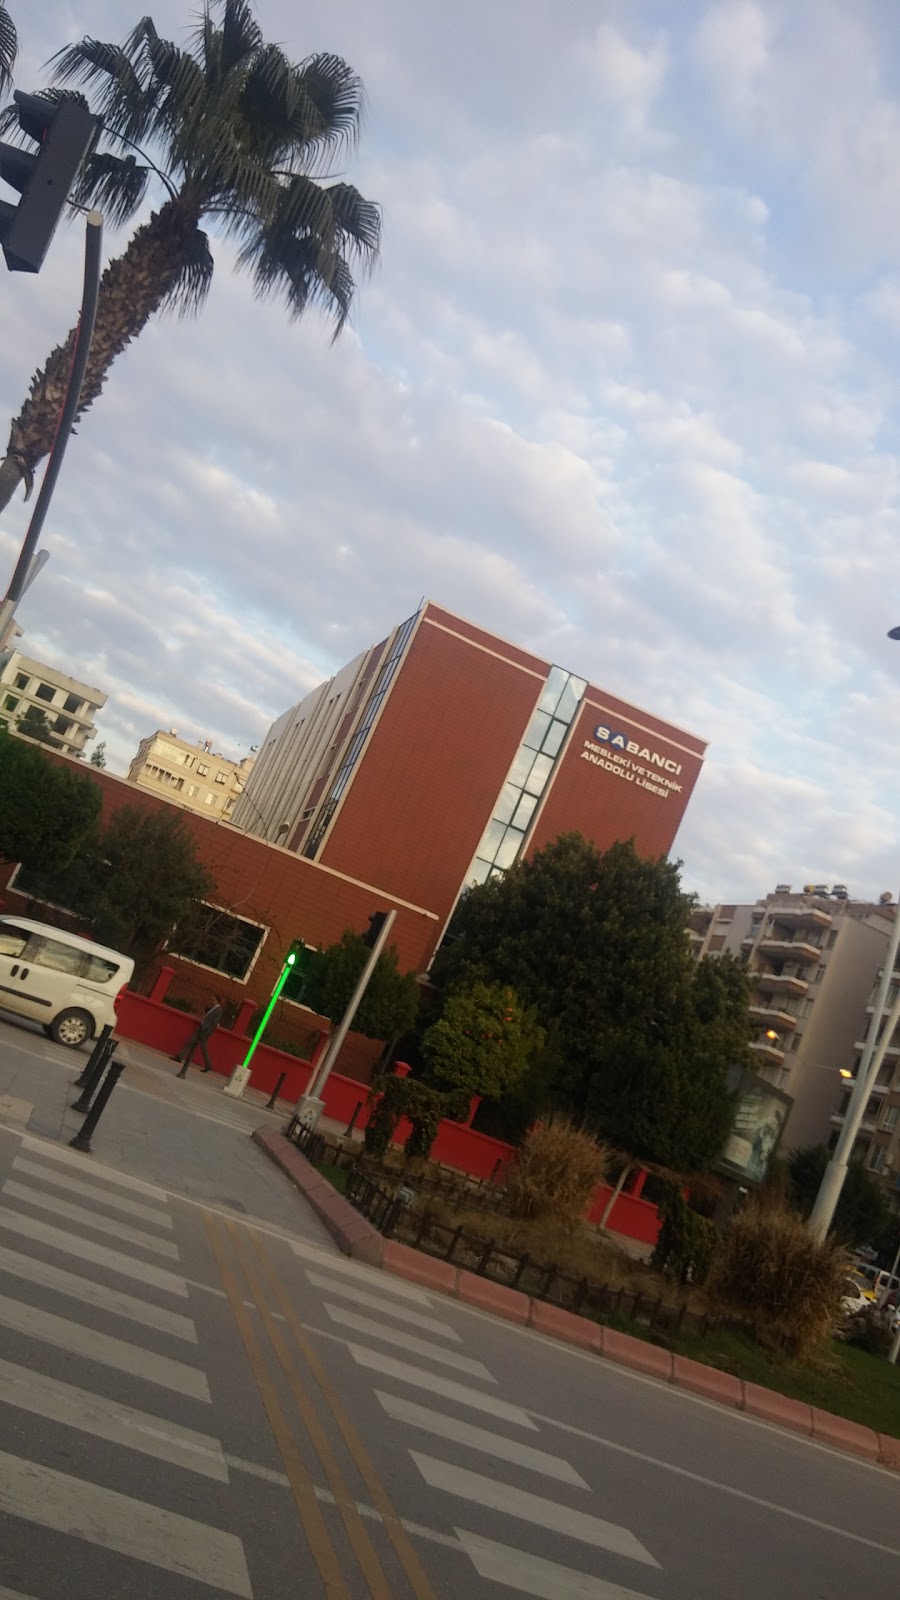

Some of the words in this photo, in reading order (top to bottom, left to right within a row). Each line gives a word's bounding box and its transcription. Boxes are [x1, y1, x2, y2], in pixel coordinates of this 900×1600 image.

[581, 751, 634, 781] ANADOLU
[635, 777, 669, 798] LİSESİ
[584, 740, 631, 768] MESLEKİ
[632, 763, 647, 775] VE
[646, 770, 683, 792] TEKNİK
[596, 726, 682, 775] SABANCI
